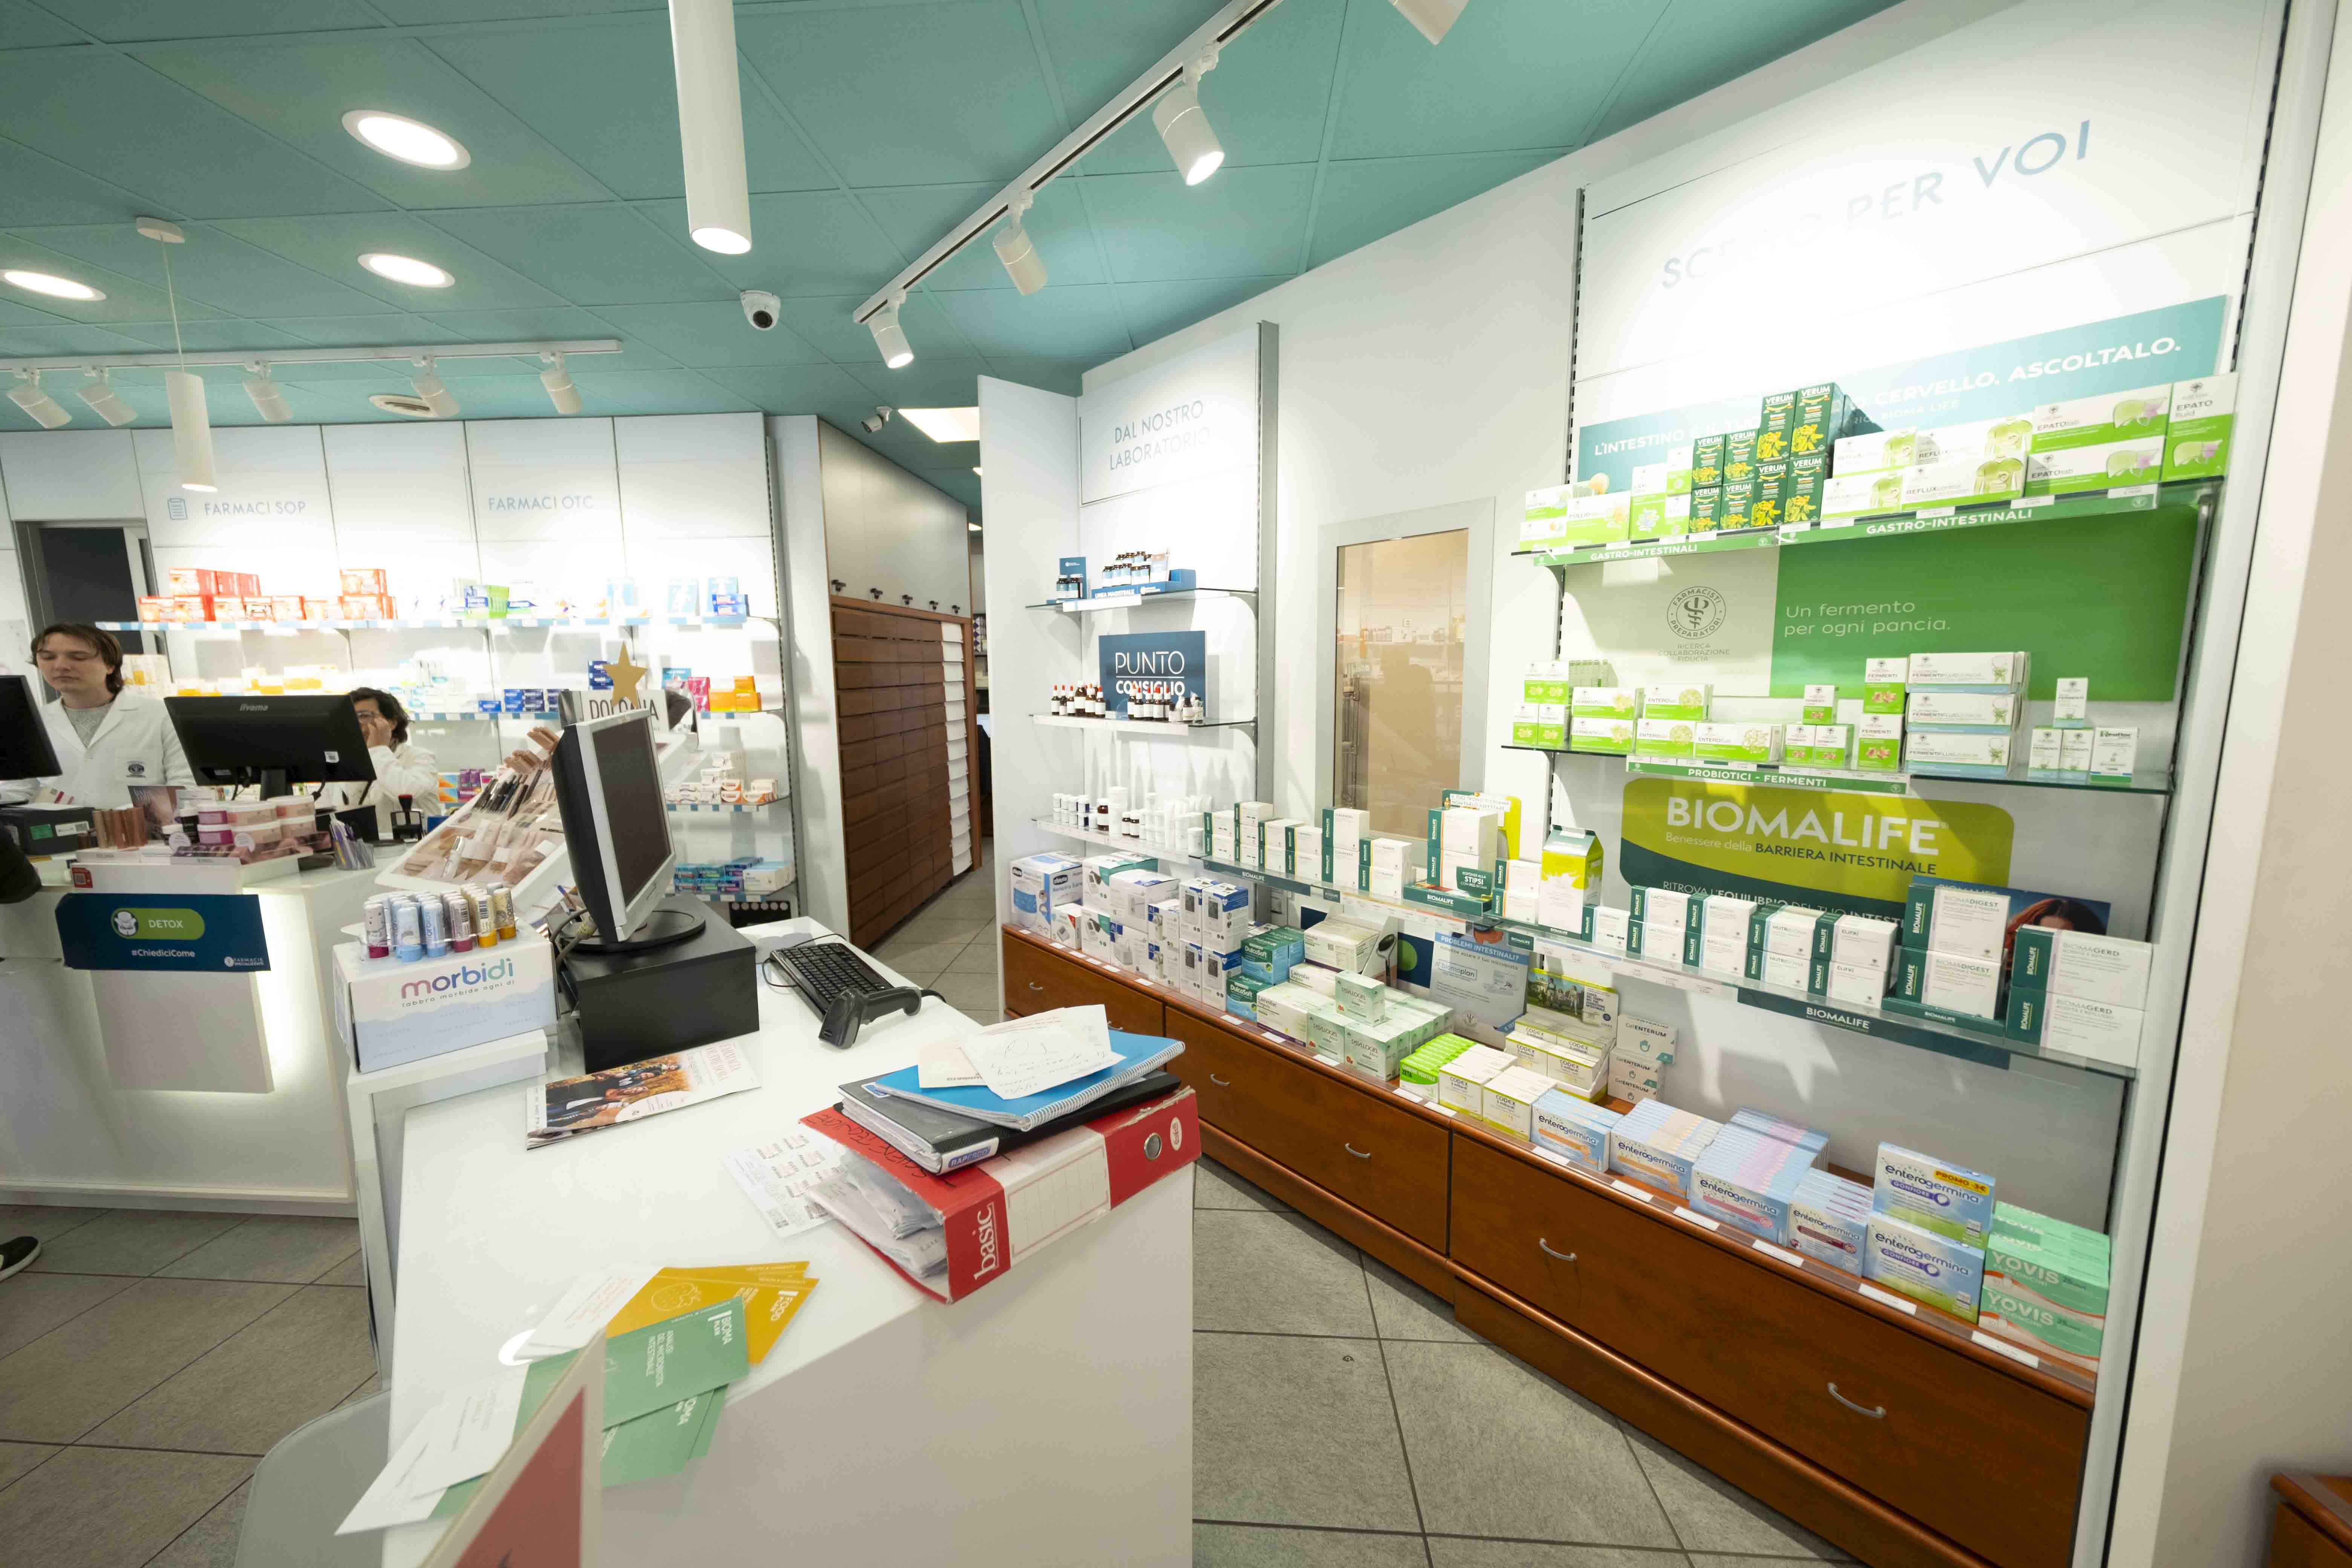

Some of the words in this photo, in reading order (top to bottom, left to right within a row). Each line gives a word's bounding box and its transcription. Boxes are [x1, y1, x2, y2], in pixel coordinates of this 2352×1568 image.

[1661, 213, 1821, 289] SCO
[1846, 172, 1944, 228] PER
[1972, 119, 2090, 188] VOI
[1595, 429, 1684, 456] L'INTESTINO
[1874, 372, 2000, 406] CERVELLO.
[2008, 337, 2182, 382] ASCOLTALO.
[1766, 393, 1794, 405] VERUM
[1801, 386, 1830, 397] VERUM
[2176, 400, 2213, 411] EPATO
[1115, 422, 1137, 444] DAL
[1141, 400, 1204, 435] NOSTRO
[1697, 436, 1722, 446] VERUM
[1730, 431, 1755, 441] VERUM
[1110, 426, 1210, 470] LABORATORIO
[1759, 464, 1786, 474] VERUM
[1793, 458, 1822, 468] VERUM
[1695, 487, 1719, 496] VERUM
[1726, 483, 1752, 492] VERUM
[204, 502, 271, 516] FARMACI
[276, 501, 306, 515] SOP
[488, 496, 557, 511] FARMACI
[562, 495, 594, 509] OTC
[1866, 509, 2032, 534] GASTRO-INTESTINALI
[1590, 544, 1697, 561] GASTRO-INTESTINALI
[1673, 588, 1721, 606] FARMACISTI
[1786, 605, 1811, 619] Un
[1818, 601, 1915, 618] fermento
[1671, 618, 1721, 637] PREPARATORI
[1784, 622, 1816, 638] per
[1822, 620, 1865, 636] ogni
[1872, 617, 1951, 635] pancia.
[1115, 651, 1185, 674] PUNTO
[1115, 680, 1185, 696] CONSIGLIO
[590, 699, 659, 720] DOOIA
[1688, 769, 1752, 781] PROBIOTICI
[1764, 775, 1827, 787] FERMENTI
[1666, 796, 1939, 856] BIOMALIFE
[1666, 832, 1721, 850] Benessere
[1724, 839, 1752, 852] della
[1756, 843, 1826, 862] BARRIERA
[1829, 851, 1937, 875] INTESTINALE
[1242, 871, 1266, 881] BIOMALIFE
[1464, 876, 1484, 885] STIPSI
[1663, 881, 1707, 895] RITROVA
[1427, 894, 1454, 905] BIOMALIFE
[148, 919, 184, 929] DETOX
[1913, 902, 1923, 934] BIOMALIFE
[131, 949, 195, 958] #ChiediciCome
[1245, 946, 1267, 959] DulcoSoft
[1441, 936, 1472, 948] PROBLEMI
[1474, 945, 1519, 961] INTESTINALI?
[2026, 946, 2037, 975] BIOMALIFE
[401, 958, 513, 999] morbidi
[1441, 963, 1475, 978] biomaplan
[1905, 965, 1915, 995] BIOMALIFE
[401, 997, 436, 1008] labbra
[440, 987, 479, 1000] morbide
[482, 982, 504, 994] ogni
[1230, 985, 1253, 998] DulcoSoft
[1258, 995, 1277, 1008] Laevolac
[1806, 1007, 1871, 1029] BIOMALIFE
[1925, 1011, 1955, 1023] BIOMALIFE
[2020, 1001, 2031, 1031] BIOMALIFE
[1526, 1027, 1544, 1037] CODEX
[1517, 1044, 1535, 1054] CODEX
[1568, 1041, 1589, 1050] CODEX
[1559, 1060, 1579, 1069] CODEX
[1402, 1070, 1412, 1078] ZETA
[1450, 1077, 1468, 1087] CODEX
[1496, 1095, 1516, 1106] CODEX
[1538, 1115, 1597, 1144] enterogermina
[1618, 1142, 1685, 1174] enterogermina
[1885, 1165, 1980, 1204] enterogermina
[1935, 1170, 1969, 1186] PROMO
[1700, 1179, 1777, 1216] enterogermina
[1893, 1180, 1930, 1198] GONFIORE
[1793, 1209, 1860, 1240] enterogermina
[972, 1203, 996, 1281] basic
[1875, 1233, 1969, 1276] enterogermina
[1883, 1248, 1920, 1266] GONFIORE
[1992, 1251, 2059, 1285] YOVIS
[771, 1297, 793, 1321] FOOD
[1987, 1291, 2054, 1326] YOVIS
[721, 1317, 733, 1345] BIOMA
